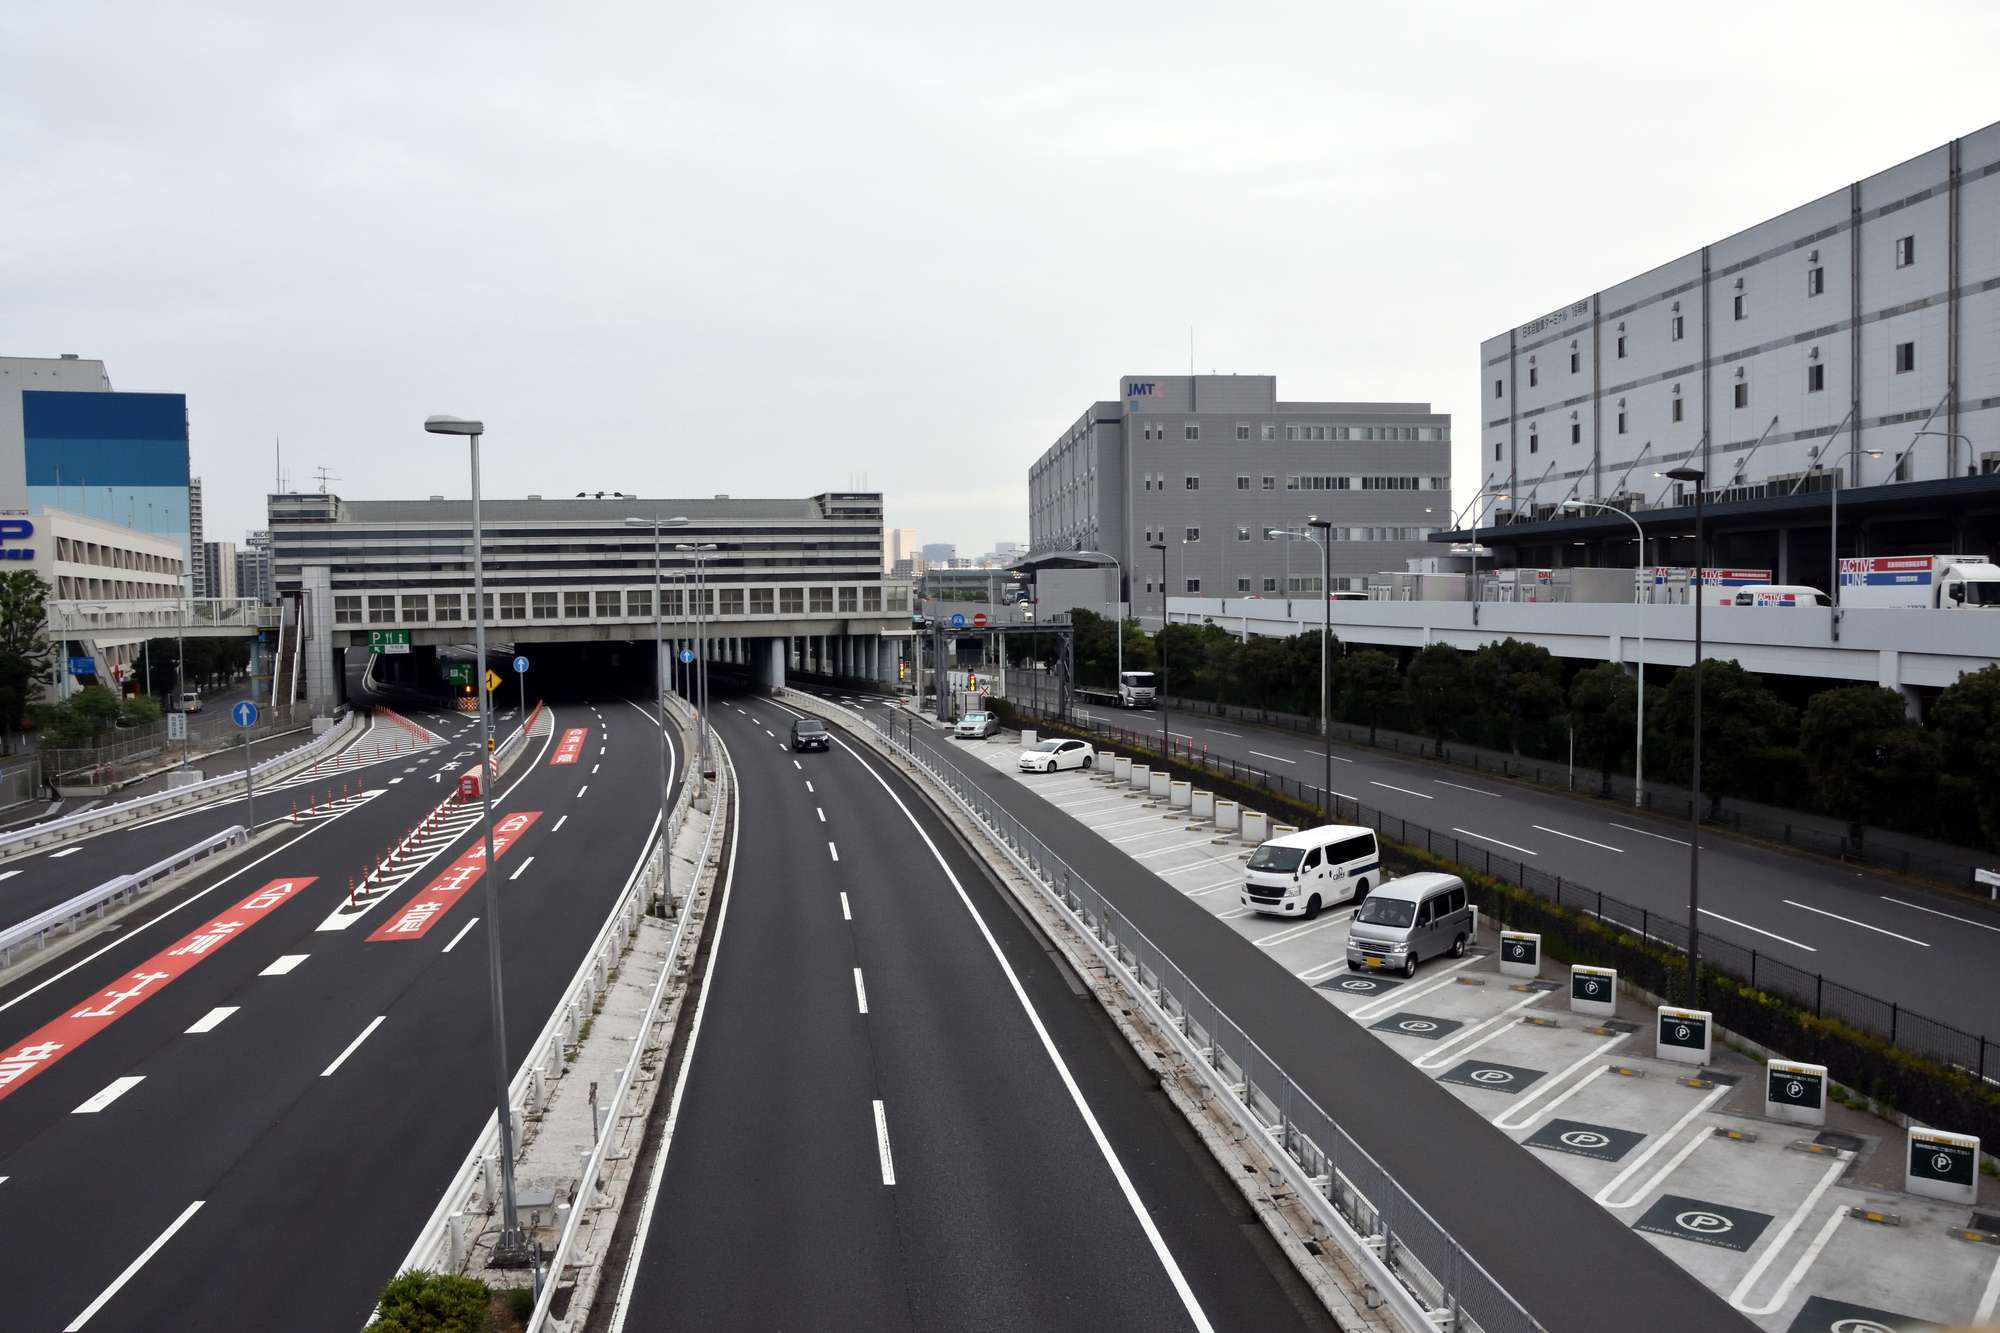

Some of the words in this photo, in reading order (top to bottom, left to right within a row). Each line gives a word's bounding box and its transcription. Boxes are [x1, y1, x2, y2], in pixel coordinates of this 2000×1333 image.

[1127, 384, 1156, 397] JMT
[1841, 560, 1875, 573] ACTIVE
[1690, 570, 1723, 579] ATIVE
[1846, 573, 1868, 587] LINE
[1758, 593, 1785, 601] ACTIVE
